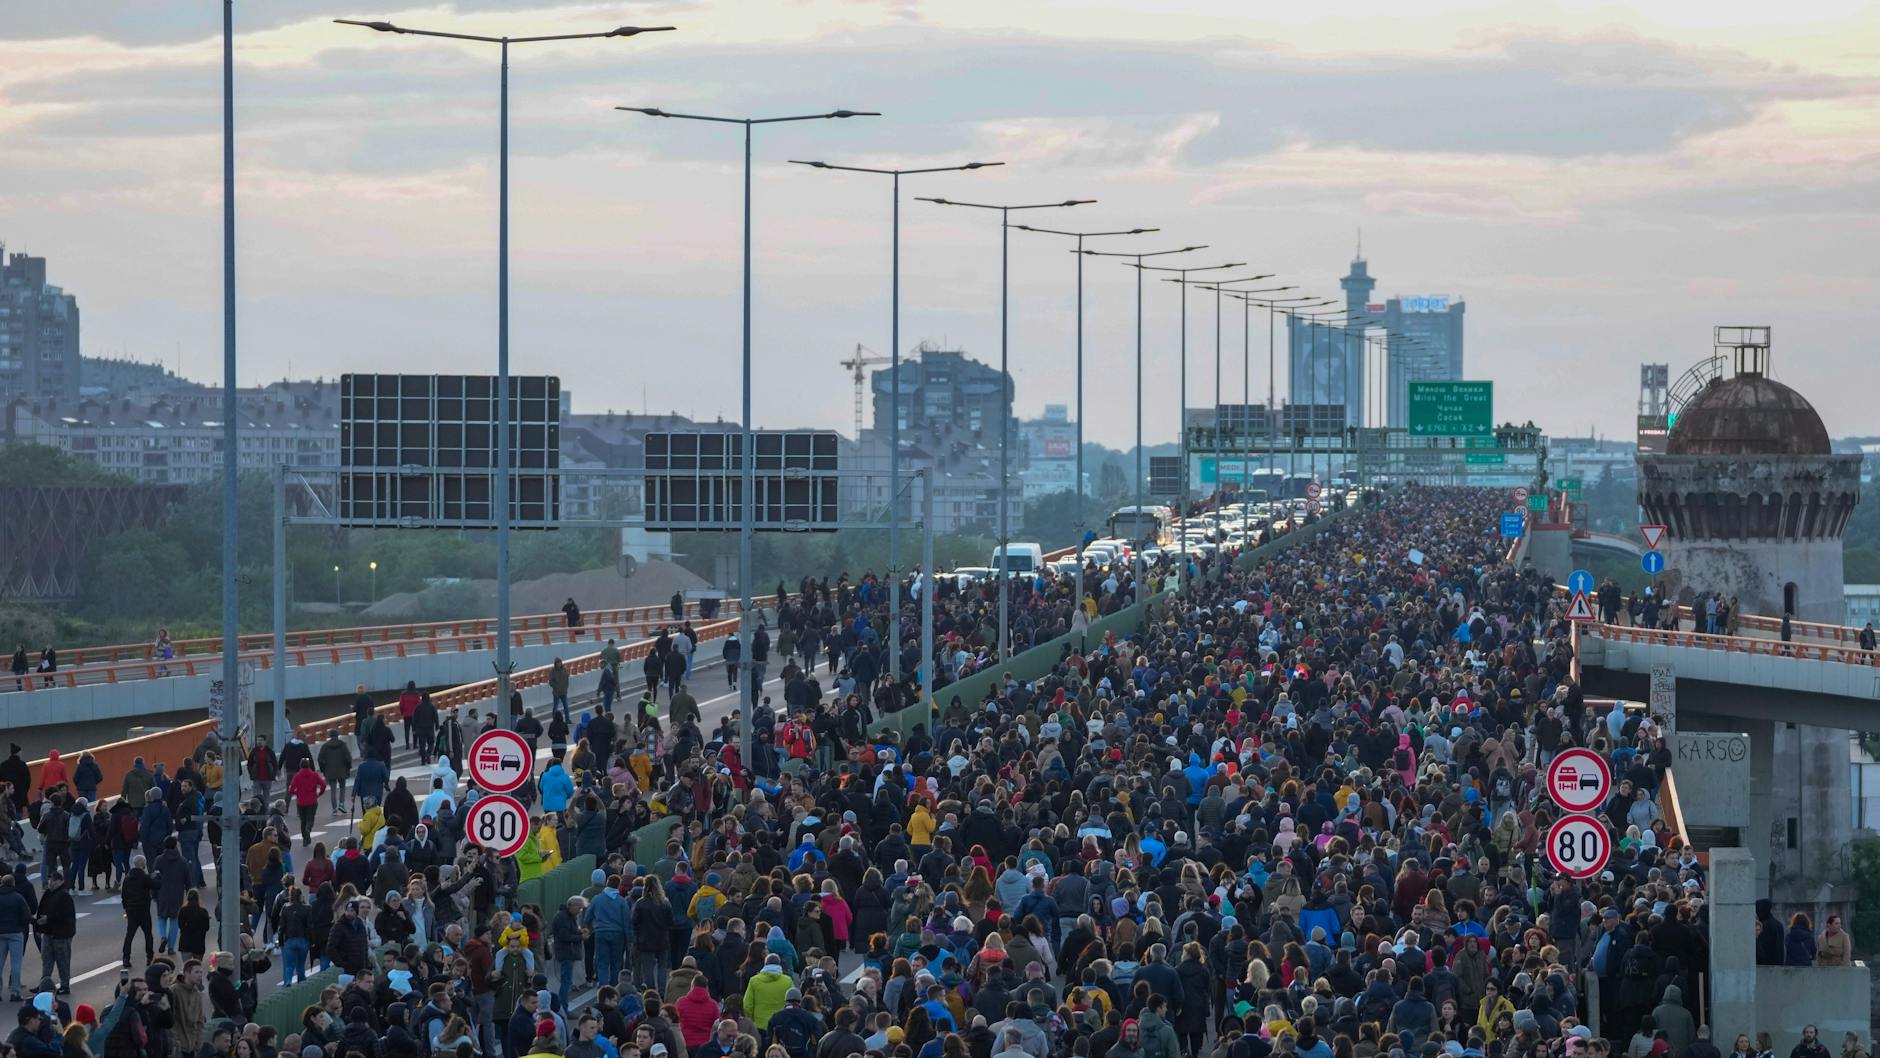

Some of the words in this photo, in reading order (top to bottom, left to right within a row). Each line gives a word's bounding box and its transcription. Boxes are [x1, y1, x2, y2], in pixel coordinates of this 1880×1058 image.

[1463, 394, 1488, 402] Great
[479, 810, 517, 842] 80
[1559, 830, 1598, 862] 80
